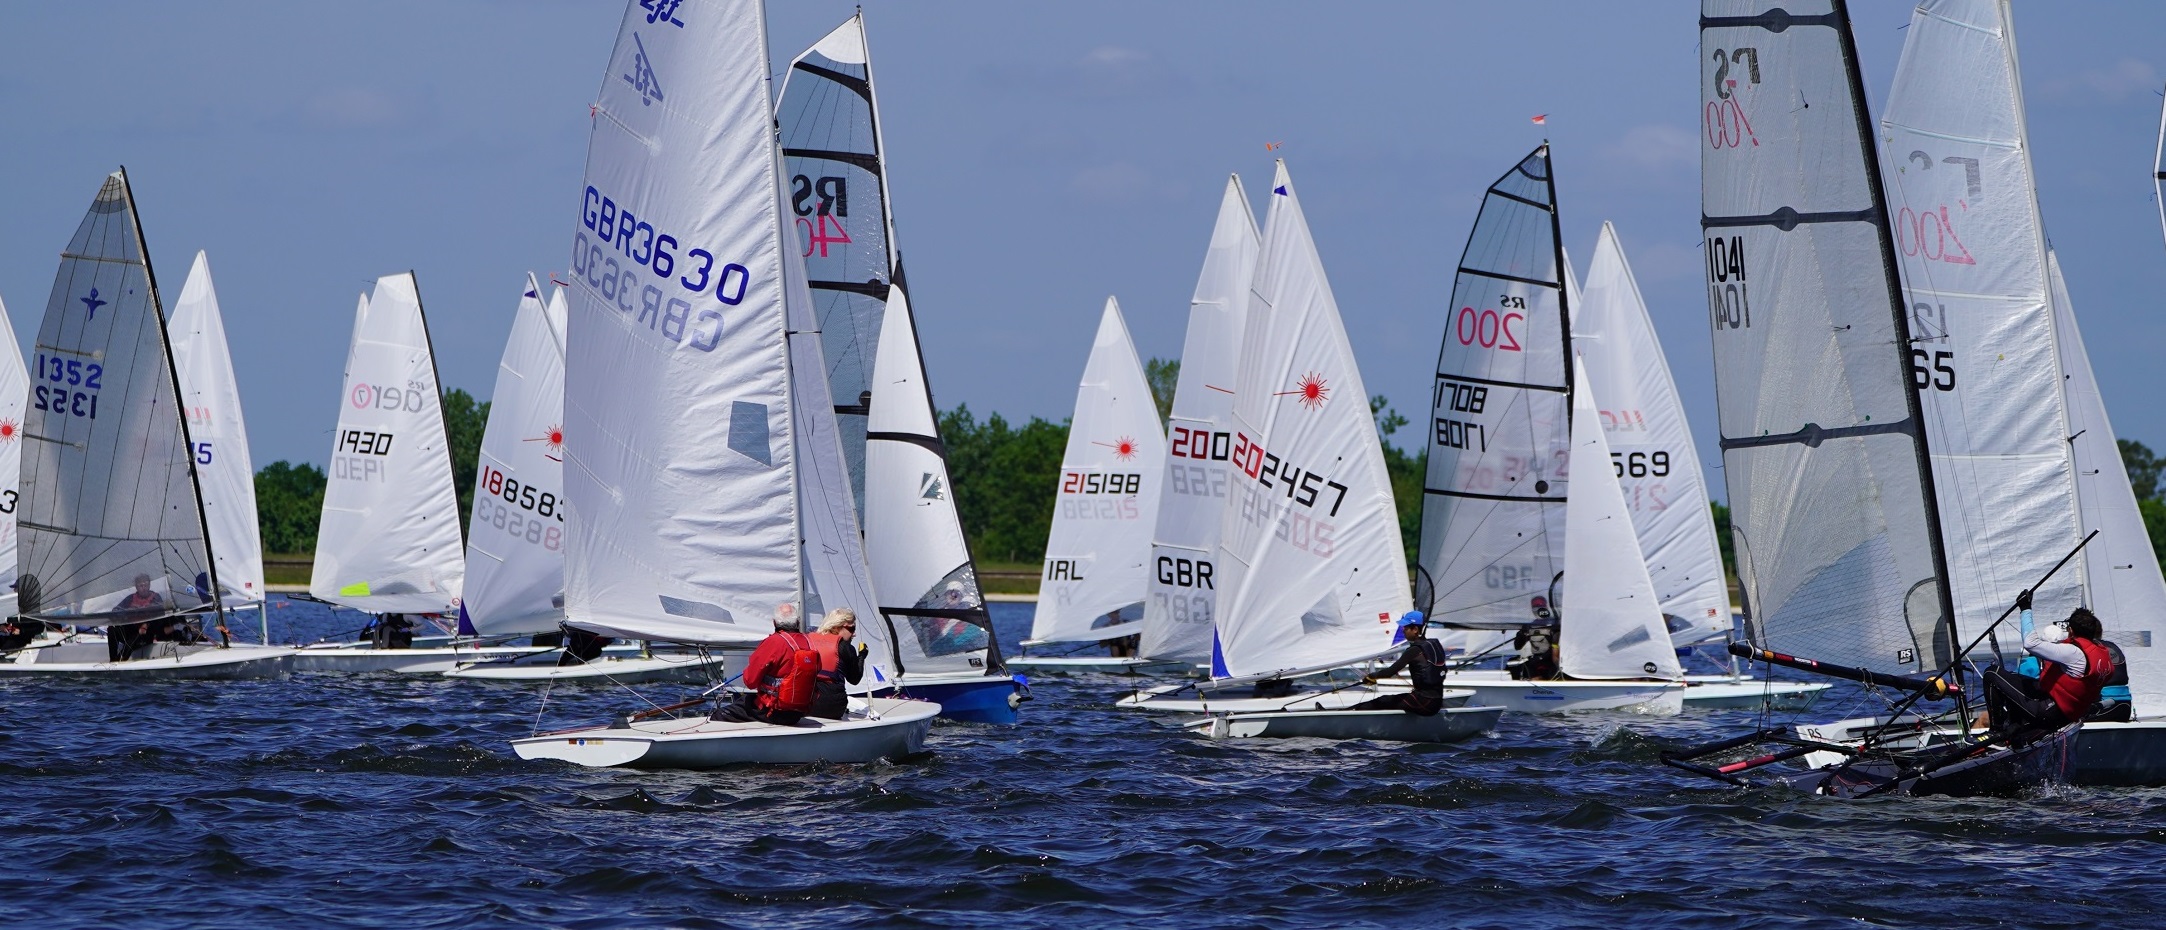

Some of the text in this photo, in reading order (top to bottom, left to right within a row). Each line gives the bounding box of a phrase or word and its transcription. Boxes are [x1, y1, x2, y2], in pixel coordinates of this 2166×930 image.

[583, 185, 750, 306] GBR3630
[1708, 235, 1746, 283] 1041
[38, 354, 104, 389] 1352
[1436, 381, 1489, 414] 1708
[338, 429, 394, 456] 1930
[1171, 426, 1231, 461] 200
[1063, 472, 1141, 494] 215198
[1231, 431, 1349, 518] 202457
[1047, 560, 1084, 581] IRL
[1156, 555, 1215, 591] GBR
[1900, 649, 1912, 658] RS
[1807, 727, 1822, 739] RS
